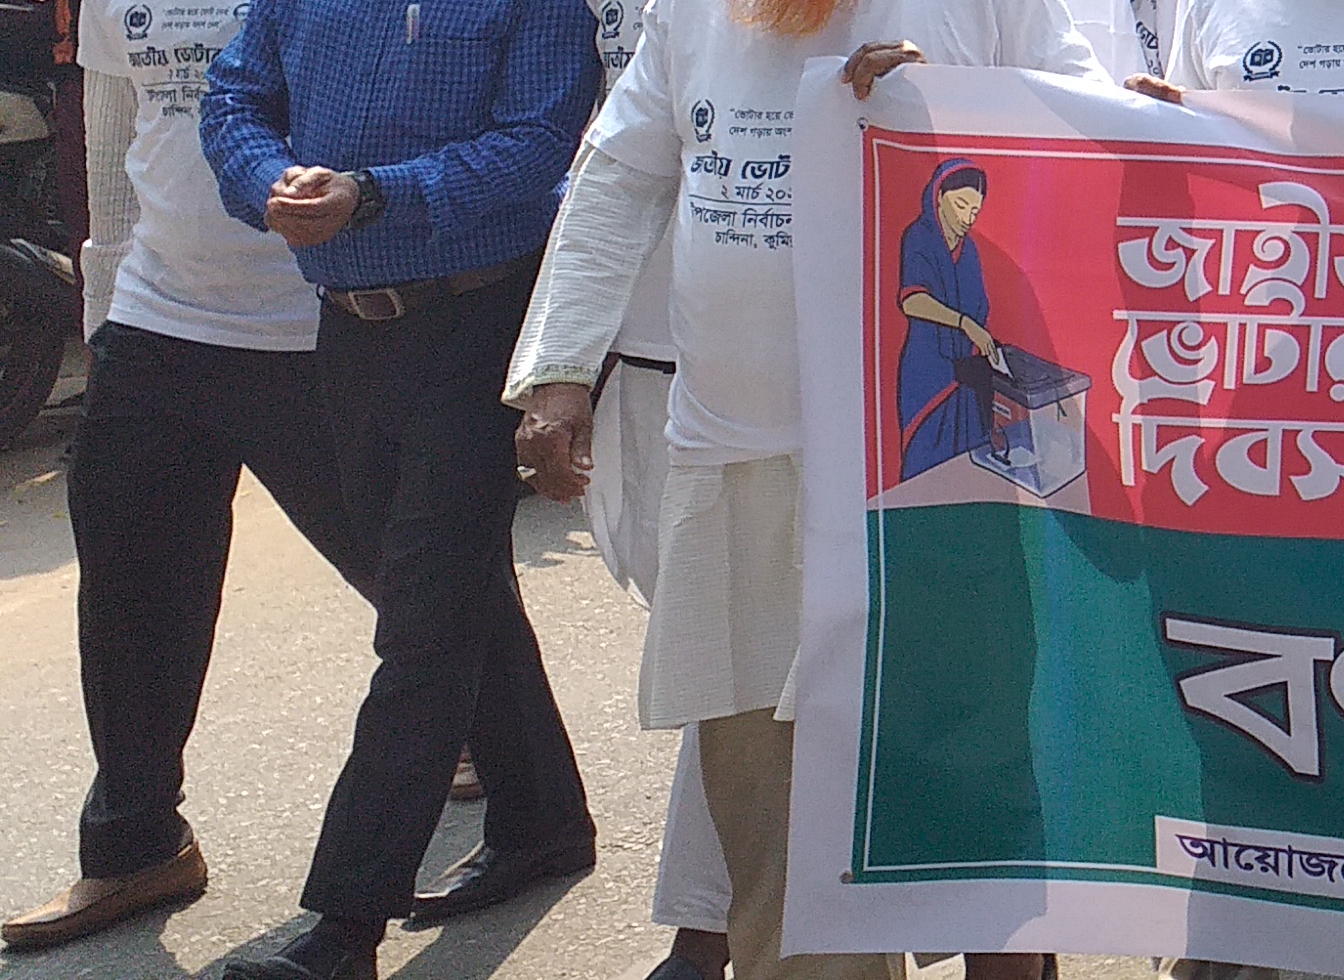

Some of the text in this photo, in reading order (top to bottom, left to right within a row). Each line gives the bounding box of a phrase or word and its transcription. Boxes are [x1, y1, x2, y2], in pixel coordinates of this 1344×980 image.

[1299, 59, 1316, 70] দেশ
[1319, 58, 1341, 70] গড়ায়
[766, 109, 782, 120] হয়ে
[729, 126, 773, 139] দেশ গড়ায়
[721, 182, 764, 200] ২ মার্চ
[715, 228, 758, 249] চান্দিনা,
